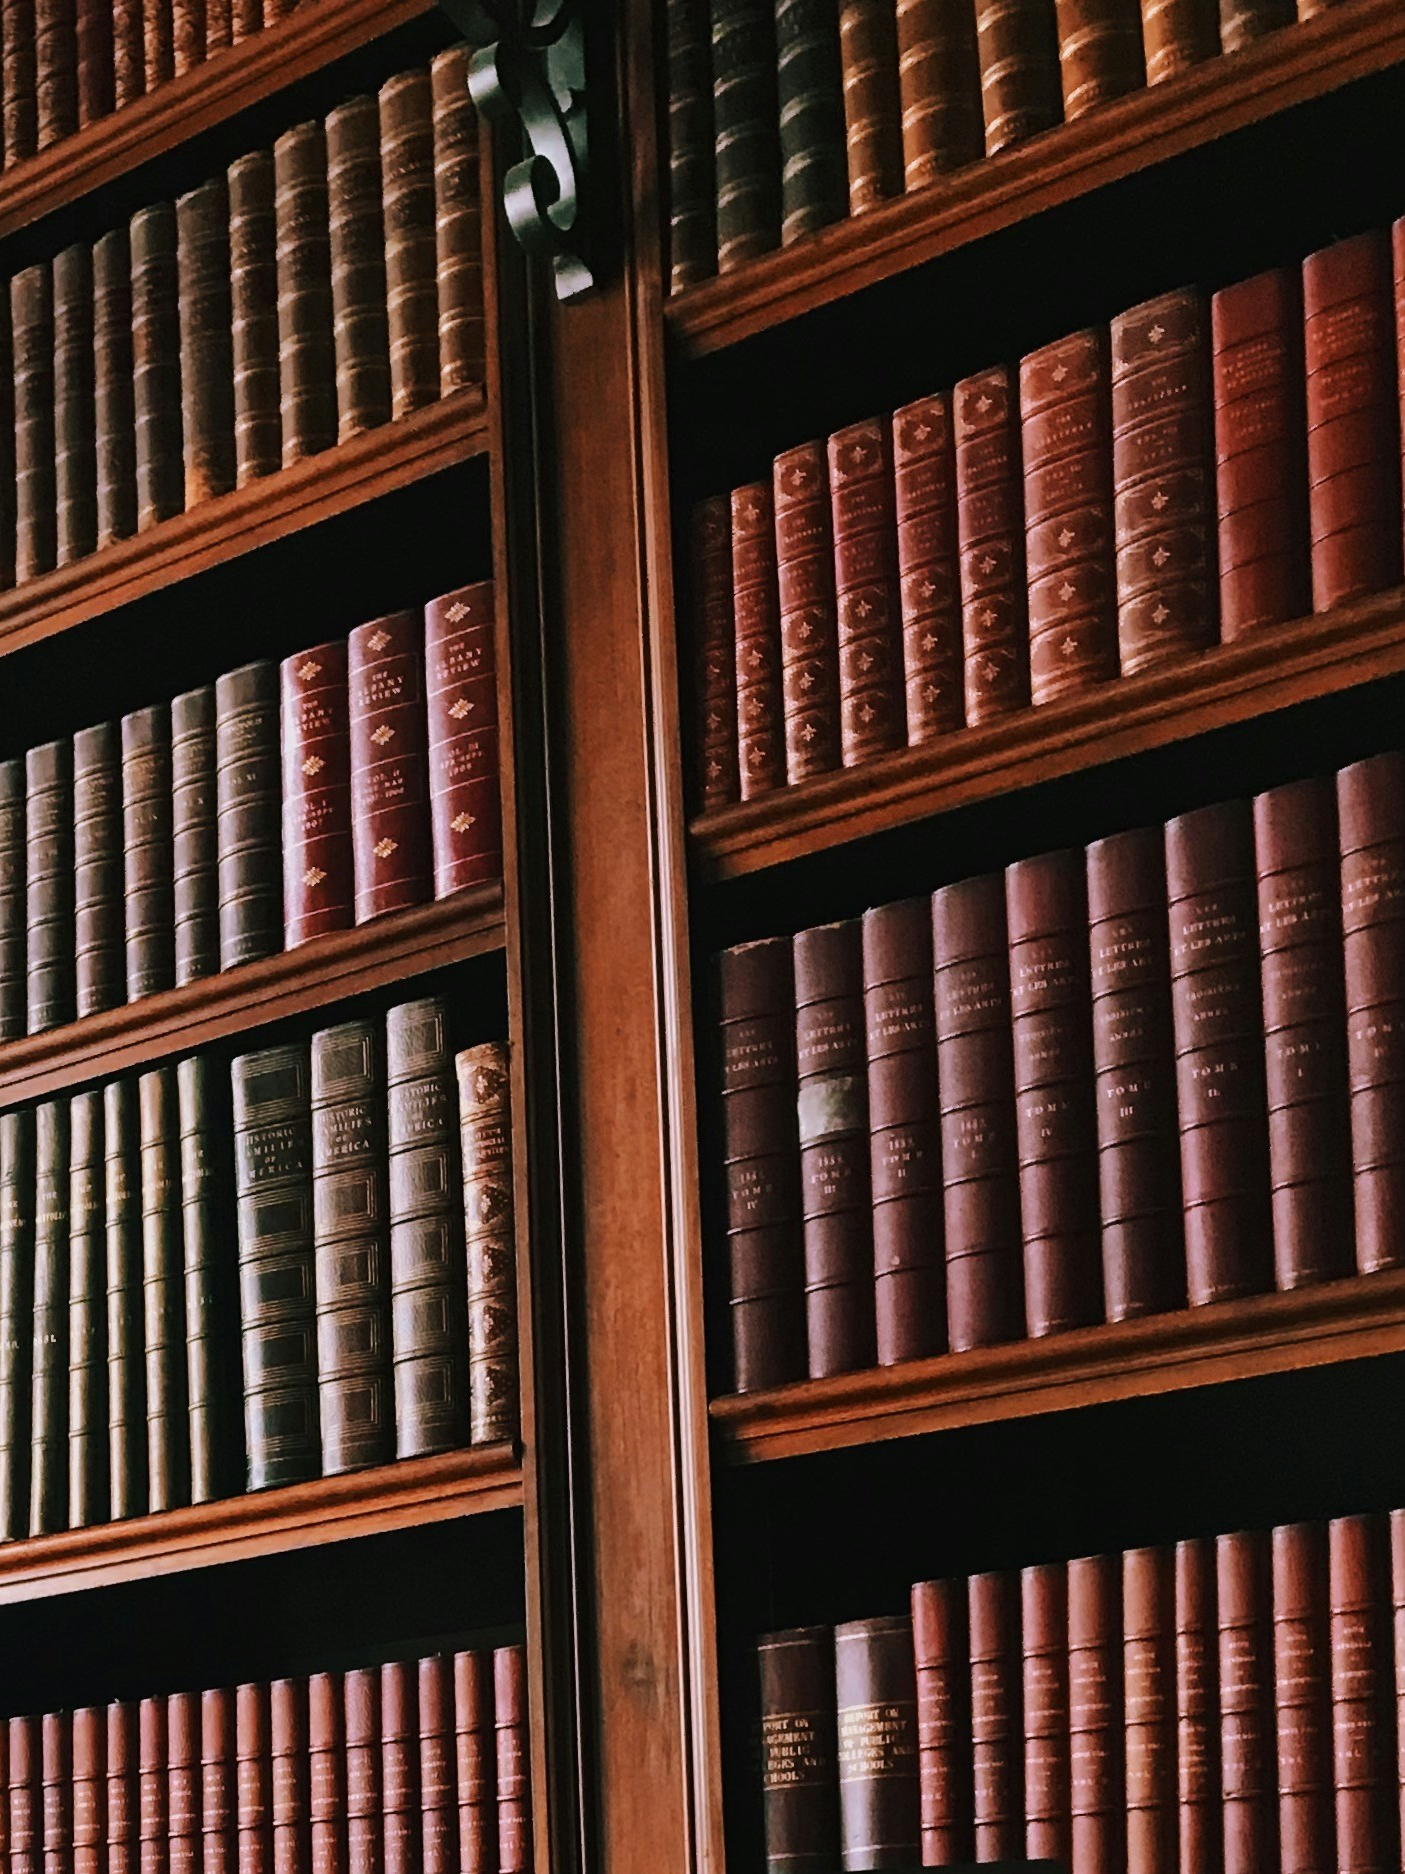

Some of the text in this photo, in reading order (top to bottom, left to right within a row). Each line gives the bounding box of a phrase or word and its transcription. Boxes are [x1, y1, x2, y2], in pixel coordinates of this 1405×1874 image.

[885, 1707, 900, 1718] ON
[763, 1718, 809, 1731] PORT ON
[860, 1734, 897, 1747] PUBLIC
[847, 1759, 894, 1774] SCHOOLS
[763, 1770, 806, 1784] CHOOLS
